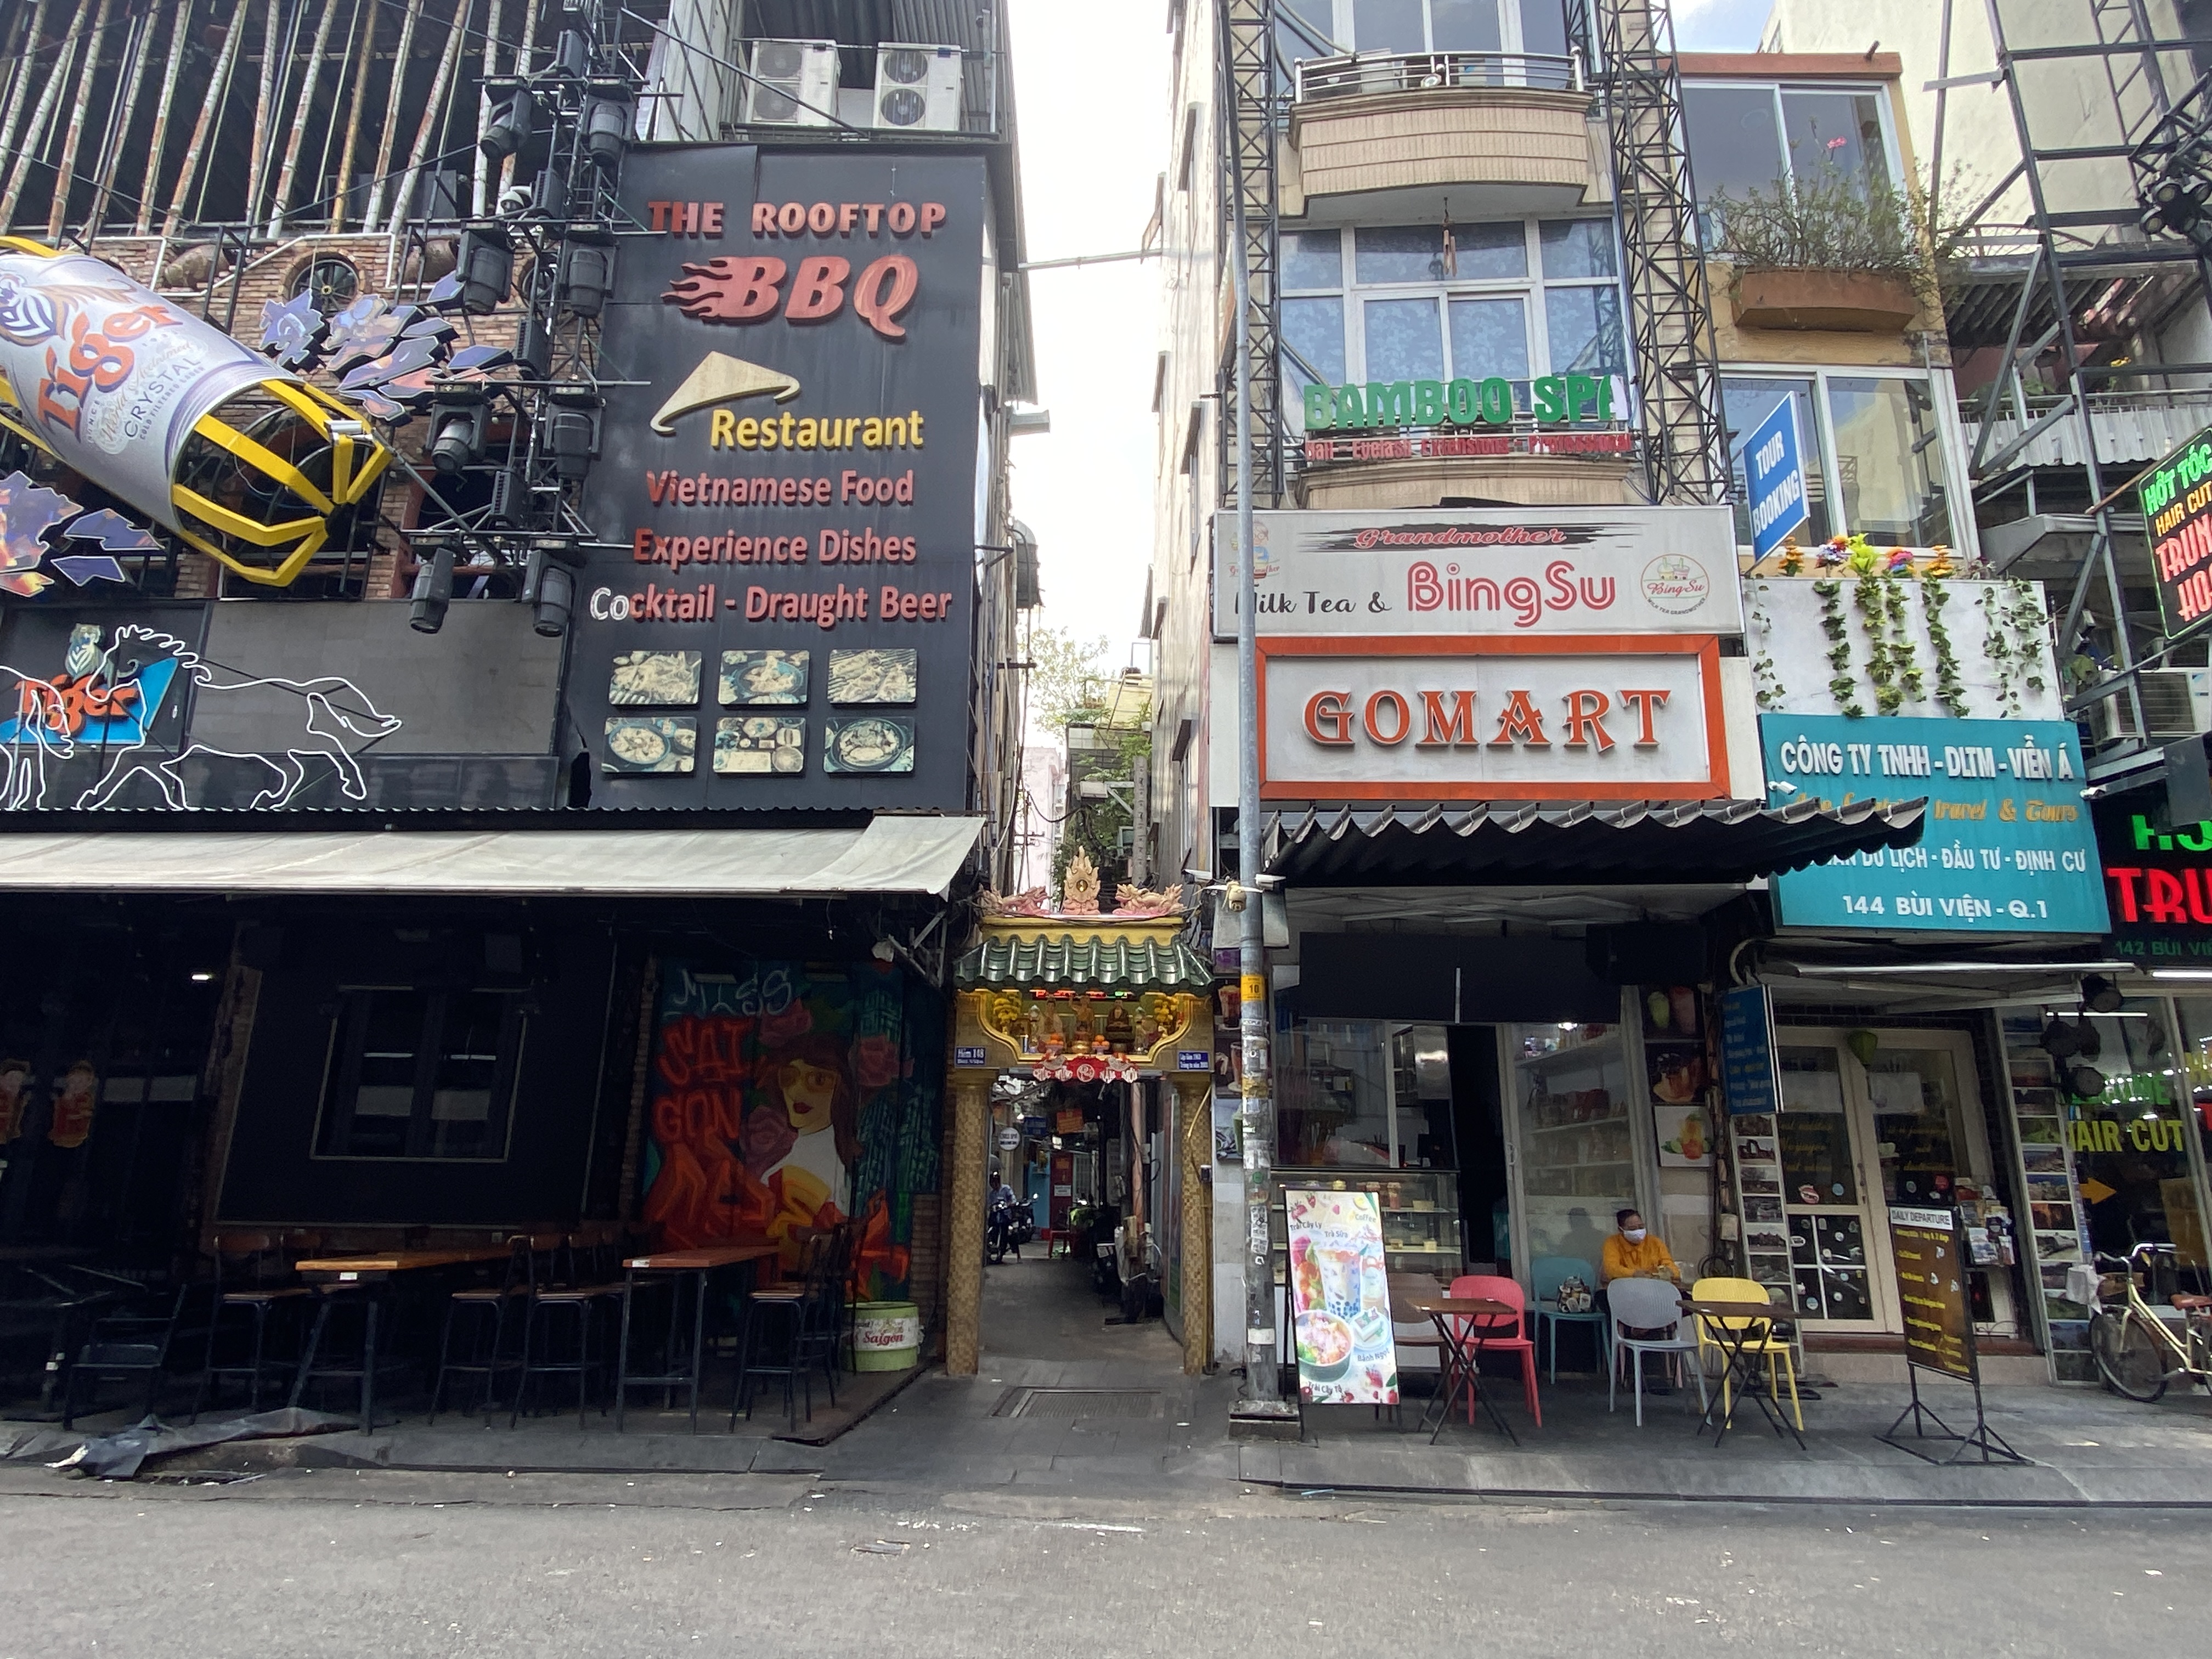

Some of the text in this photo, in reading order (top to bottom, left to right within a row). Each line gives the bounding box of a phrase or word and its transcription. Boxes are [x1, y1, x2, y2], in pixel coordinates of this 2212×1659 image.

[647, 201, 946, 236] THE ROOFTOP
[661, 256, 919, 337] BBQ
[38, 306, 183, 443] Tiger
[124, 357, 201, 437] CRYSTAL
[1304, 375, 1628, 430] BAMBOO SPA
[710, 409, 924, 450] Restaurant
[1352, 438, 1412, 460] Eyelash
[1756, 430, 1785, 481] TOUR
[2177, 443, 2212, 489] TÓC
[647, 471, 913, 506] Vietnamese Food
[1752, 469, 1801, 539] BOOKING
[2155, 480, 2212, 537] HAIR CUT
[634, 527, 916, 571] Experience Dishes
[1353, 527, 1567, 549] Grandmother
[2155, 512, 2212, 583] TRUN
[590, 584, 716, 622] Cocktail
[746, 584, 868, 629] Draught
[881, 586, 952, 622] Beer
[1303, 591, 1356, 614] Tea
[1368, 591, 1392, 613] &
[1408, 560, 1616, 628] BingSu
[1302, 689, 1671, 754] GOMART
[1781, 734, 1843, 775] CÔNG
[1847, 743, 1871, 775] TY
[1877, 744, 1931, 777] TNHH
[2058, 742, 2074, 780] Á
[1999, 798, 2018, 822] &
[2025, 799, 2079, 822] Tours
[1889, 848, 1928, 873] LỊCH
[1941, 839, 1975, 870] ĐẦU
[1980, 846, 2001, 871] TƯ
[2015, 850, 2056, 877] ĐỊNH
[2062, 849, 2086, 872] CƯ
[1842, 895, 1884, 915] 144
[1896, 890, 1933, 916] BÙI
[1938, 893, 1992, 923] VIỆN
[2115, 941, 2145, 956] 142
[1249, 984, 1260, 994] 10
[656, 1016, 756, 1087] SAI
[653, 1088, 744, 1144] GON
[2131, 1119, 2184, 1152] CUT
[1355, 1214, 1376, 1223] Coffee
[1891, 1210, 1951, 1226] DAILY DEPARTURE
[863, 1330, 903, 1347] Saigon
